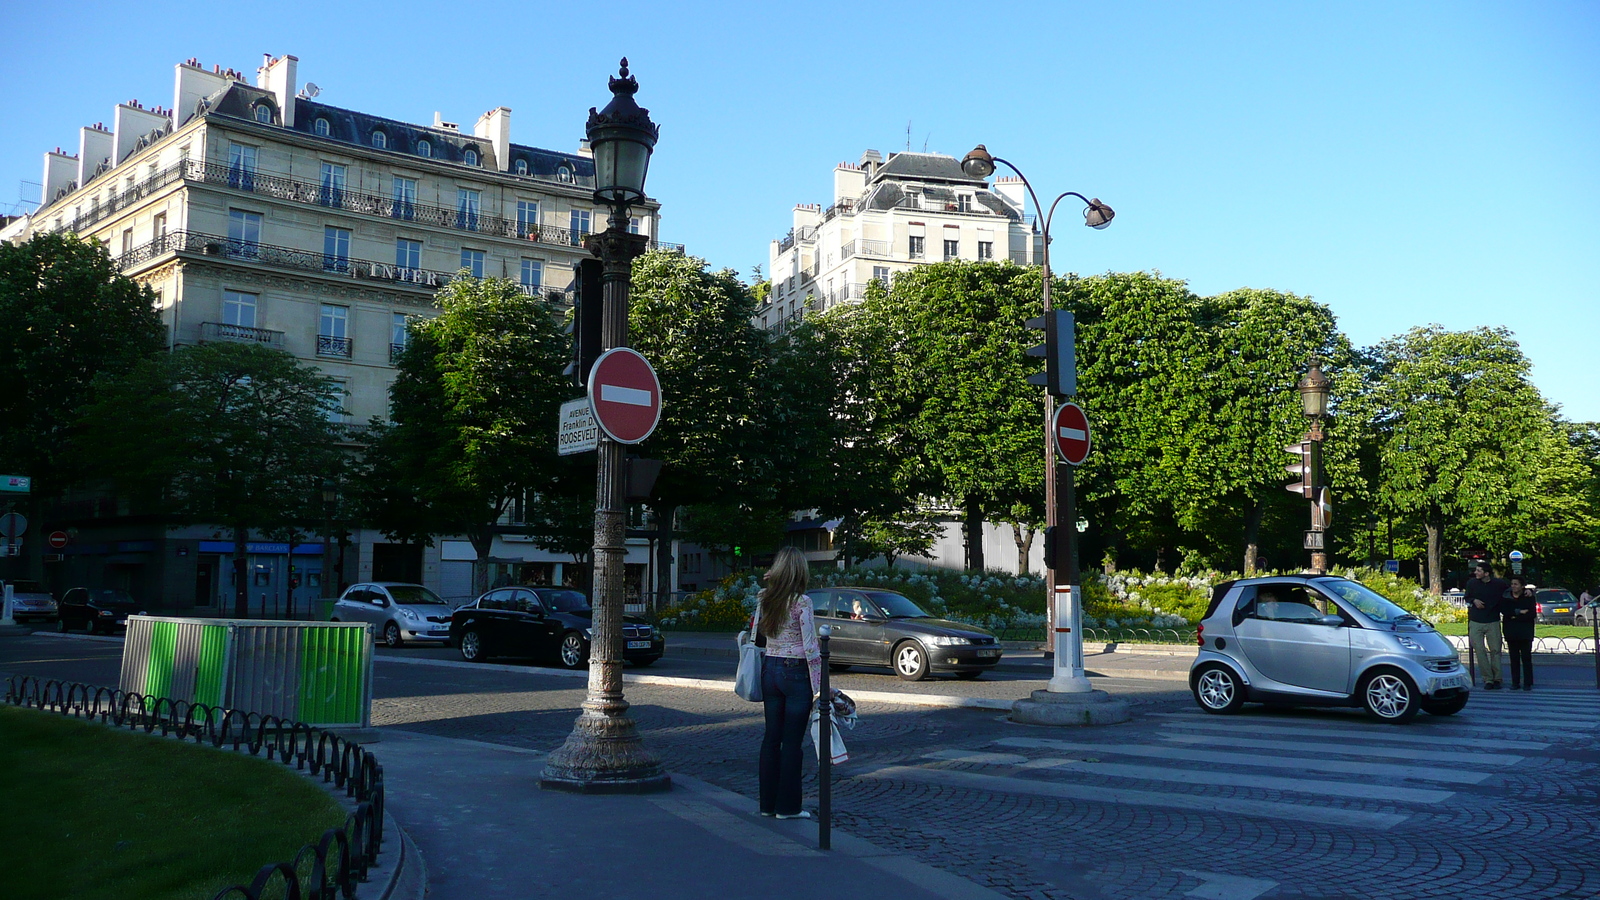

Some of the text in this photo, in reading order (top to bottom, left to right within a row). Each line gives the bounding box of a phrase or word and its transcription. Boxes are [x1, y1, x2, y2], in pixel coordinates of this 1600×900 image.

[569, 407, 590, 418] AVENUE
[563, 419, 587, 431] Franklin
[560, 427, 597, 445] ROOSEVELT
